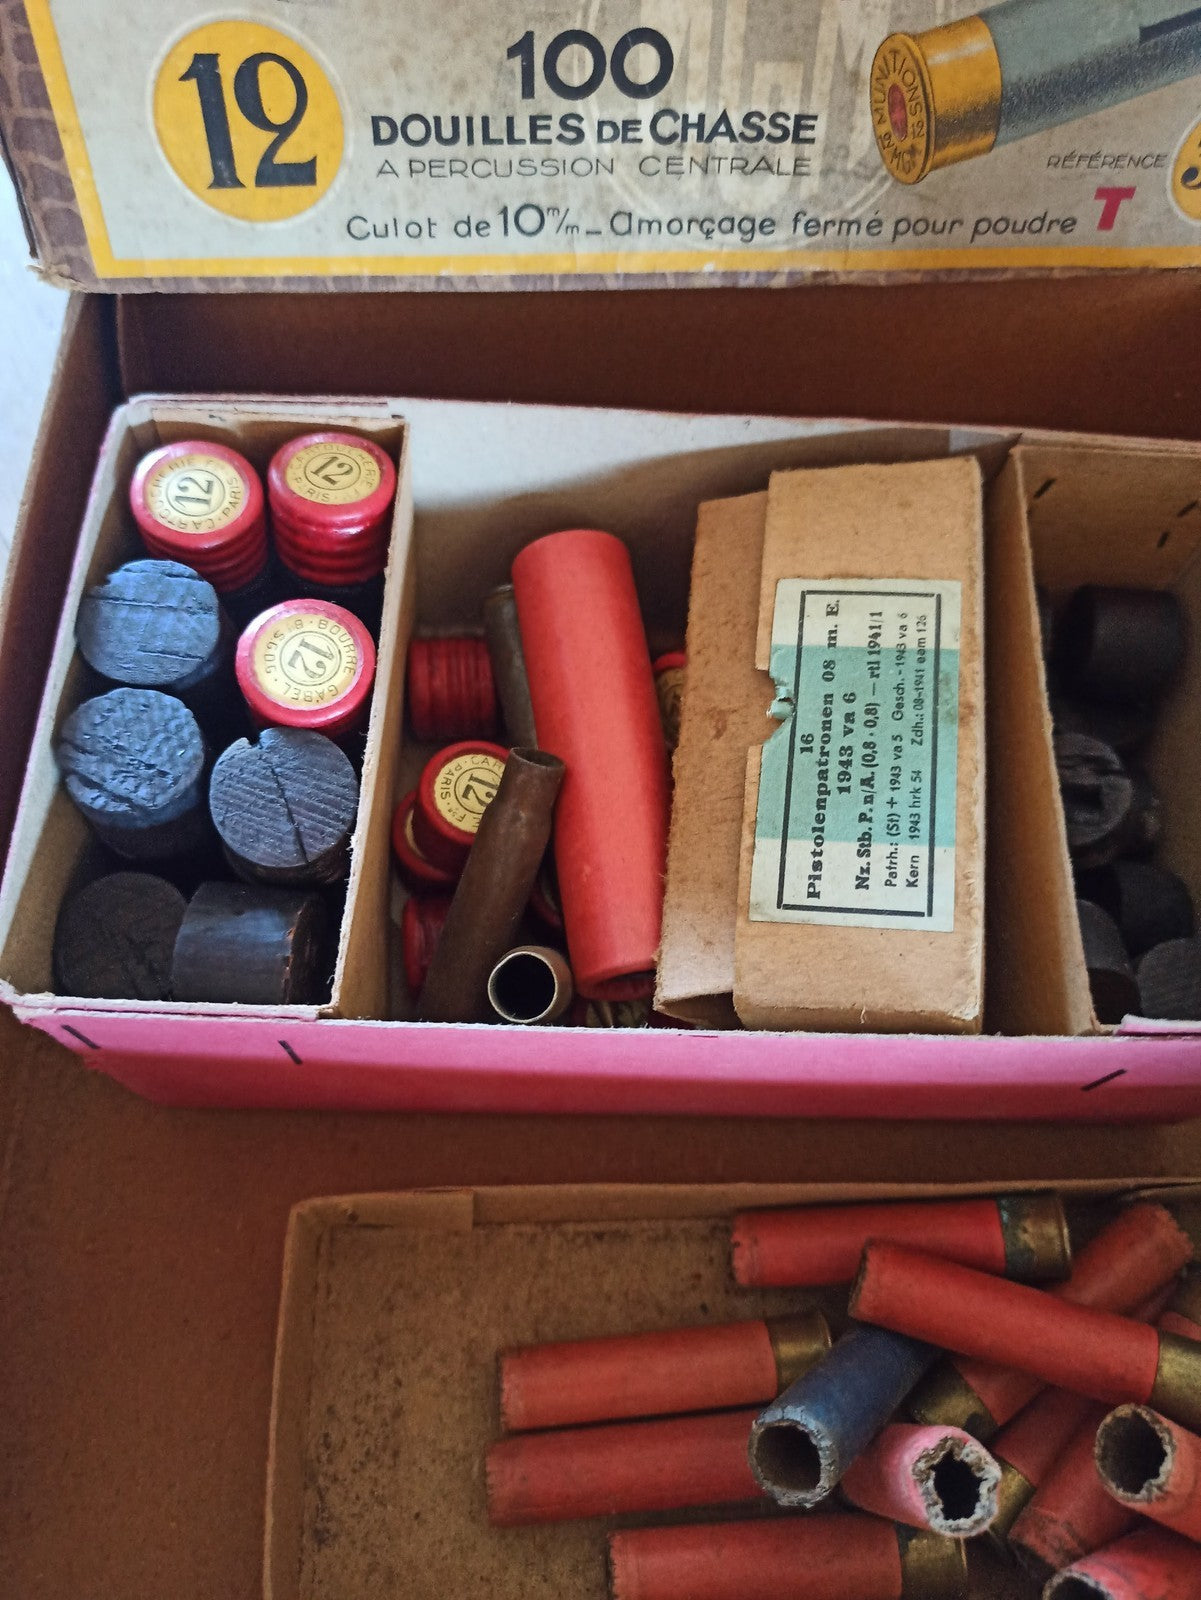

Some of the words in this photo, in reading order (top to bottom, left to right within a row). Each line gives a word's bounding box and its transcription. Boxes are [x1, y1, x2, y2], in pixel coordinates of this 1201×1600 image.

[507, 27, 674, 100] 100
[874, 49, 922, 125] MUNITIONS
[179, 52, 318, 190] 12
[372, 114, 585, 148] DOUILLES
[596, 118, 643, 144] DE
[649, 109, 819, 145] CHASSE
[377, 158, 400, 178] A
[409, 157, 616, 179] PERCUSSION
[638, 155, 811, 178] CENTRALE
[1047, 149, 1169, 170] RÉFÉRENCE
[1094, 186, 1137, 232] T
[346, 215, 438, 241] Culot
[453, 215, 491, 239] de
[792, 210, 882, 238] fermé
[891, 217, 963, 243] pour
[971, 209, 1078, 243] poudre
[310, 456, 353, 486] 12
[174, 477, 214, 511] 12
[222, 476, 241, 518] PARIS
[826, 600, 840, 617] E.
[826, 624, 838, 649] m.
[899, 624, 907, 639] va
[287, 637, 335, 679] 12
[318, 619, 357, 676] BOURRE
[822, 659, 836, 682] 08
[283, 685, 338, 703] GABEL
[842, 692, 856, 704] 6
[842, 712, 856, 738] va
[892, 734, 903, 742] 5
[800, 733, 814, 754] 16
[893, 745, 903, 761] va
[441, 764, 462, 800] PARIS
[837, 745, 853, 795] 1943
[889, 765, 902, 792] 1943
[911, 769, 922, 783] 54
[462, 773, 499, 807] 12
[807, 693, 834, 899] Pistolenpatronen
[908, 787, 922, 808] hrk
[858, 808, 873, 824] P.
[886, 813, 901, 837] (St)
[908, 813, 921, 840] 1943
[856, 827, 873, 858] Stb.
[906, 855, 920, 888] Kern
